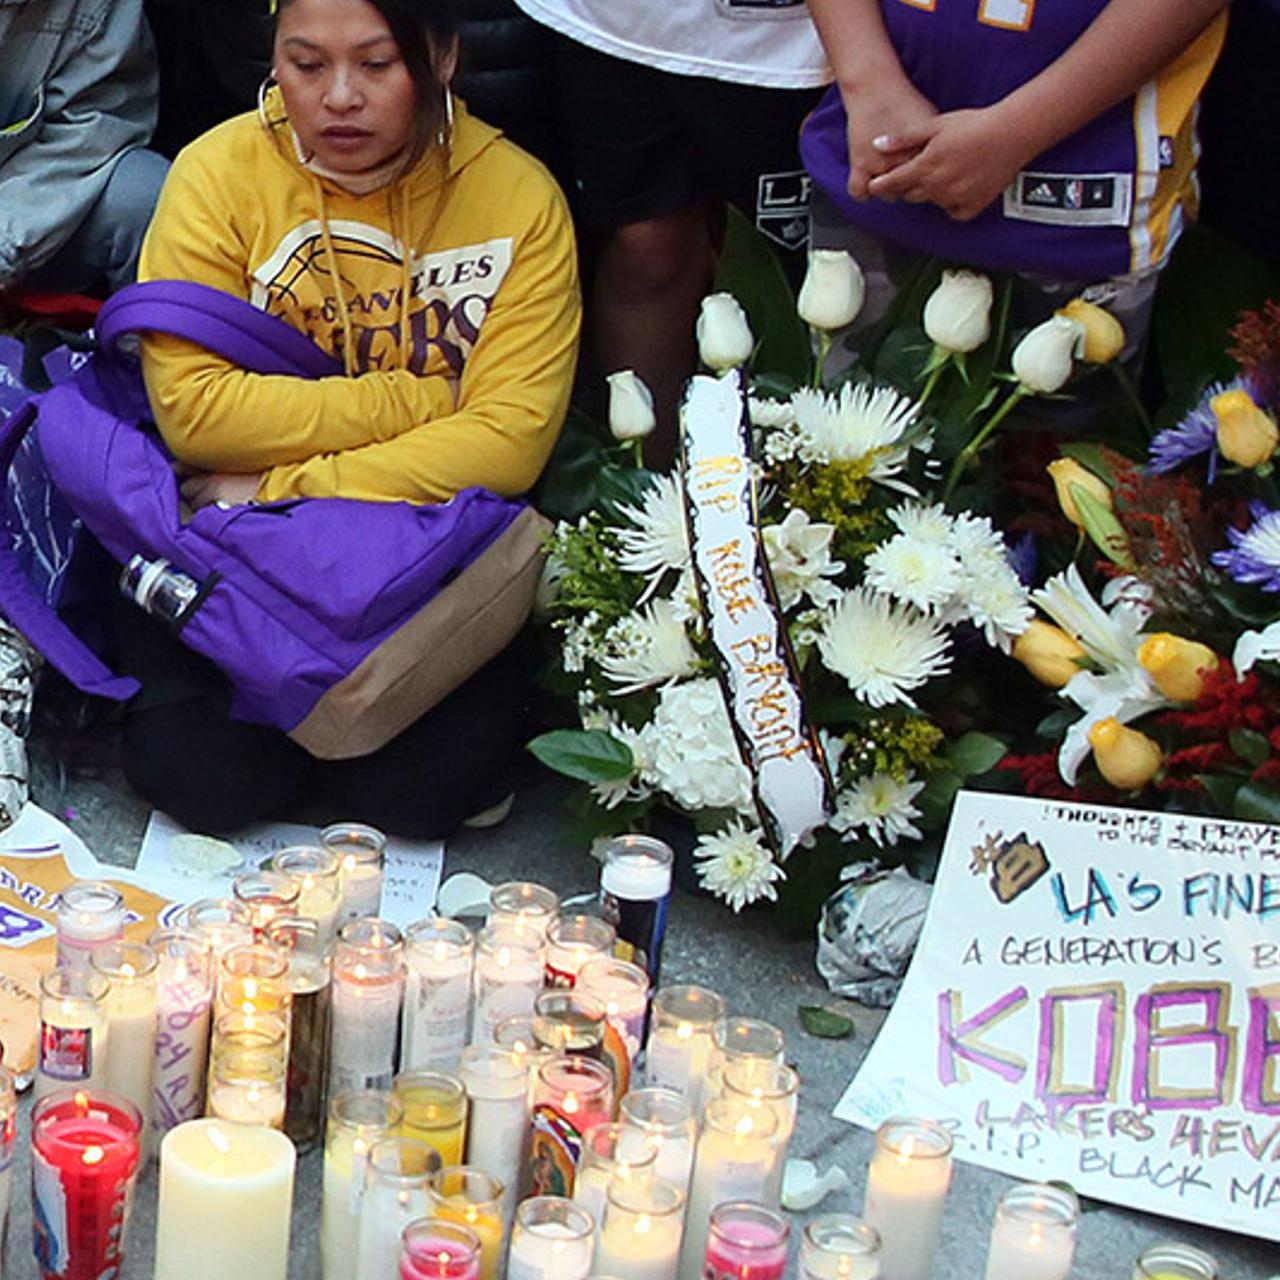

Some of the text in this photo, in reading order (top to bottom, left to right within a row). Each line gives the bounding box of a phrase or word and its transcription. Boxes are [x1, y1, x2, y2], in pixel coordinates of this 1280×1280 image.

[694, 456, 742, 514] RIP
[1097, 829, 1121, 841] TO
[962, 942, 983, 967] A
[1000, 934, 1224, 967] GENERATION'S
[1079, 1146, 1212, 1197] BLACK
